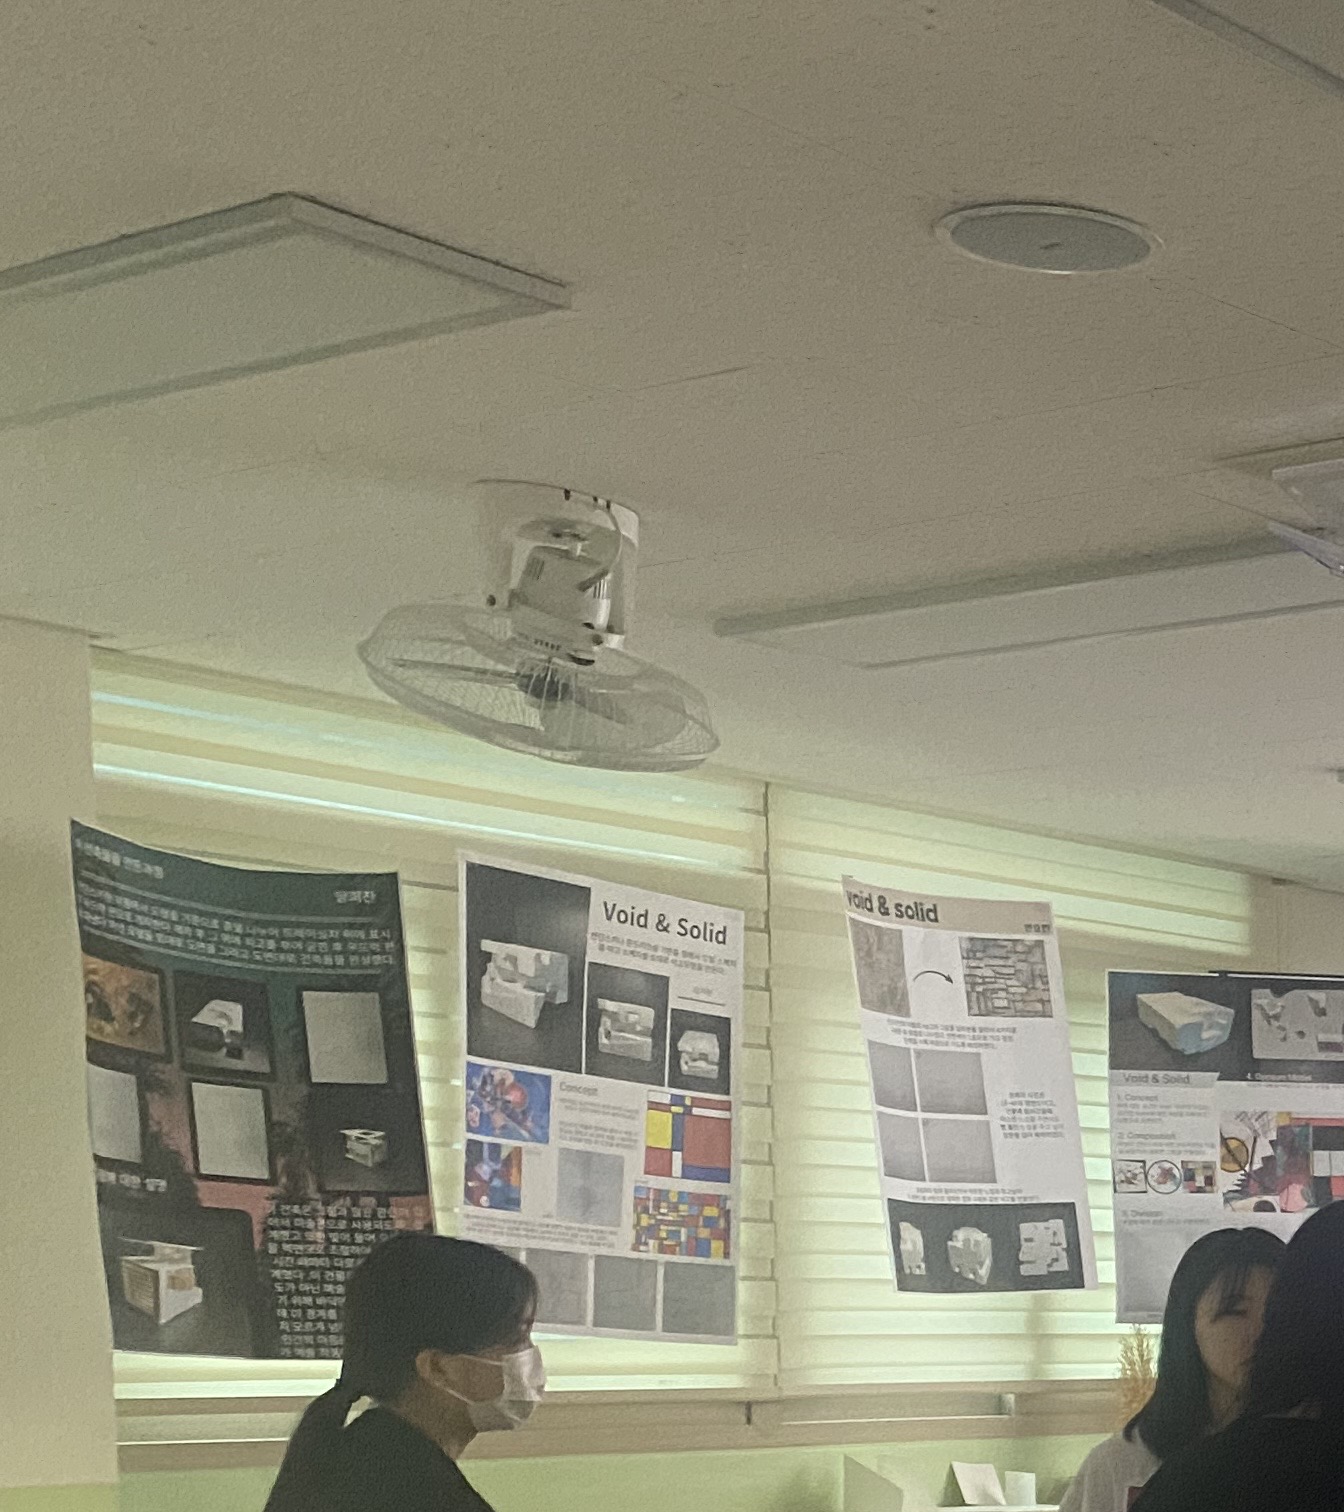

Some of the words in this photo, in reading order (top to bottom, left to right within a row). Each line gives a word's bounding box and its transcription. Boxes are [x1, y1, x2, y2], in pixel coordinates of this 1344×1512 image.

[603, 901, 649, 929] Void
[655, 913, 670, 934] &
[676, 917, 727, 946] Solid
[877, 895, 890, 916] &
[895, 901, 939, 923] solid
